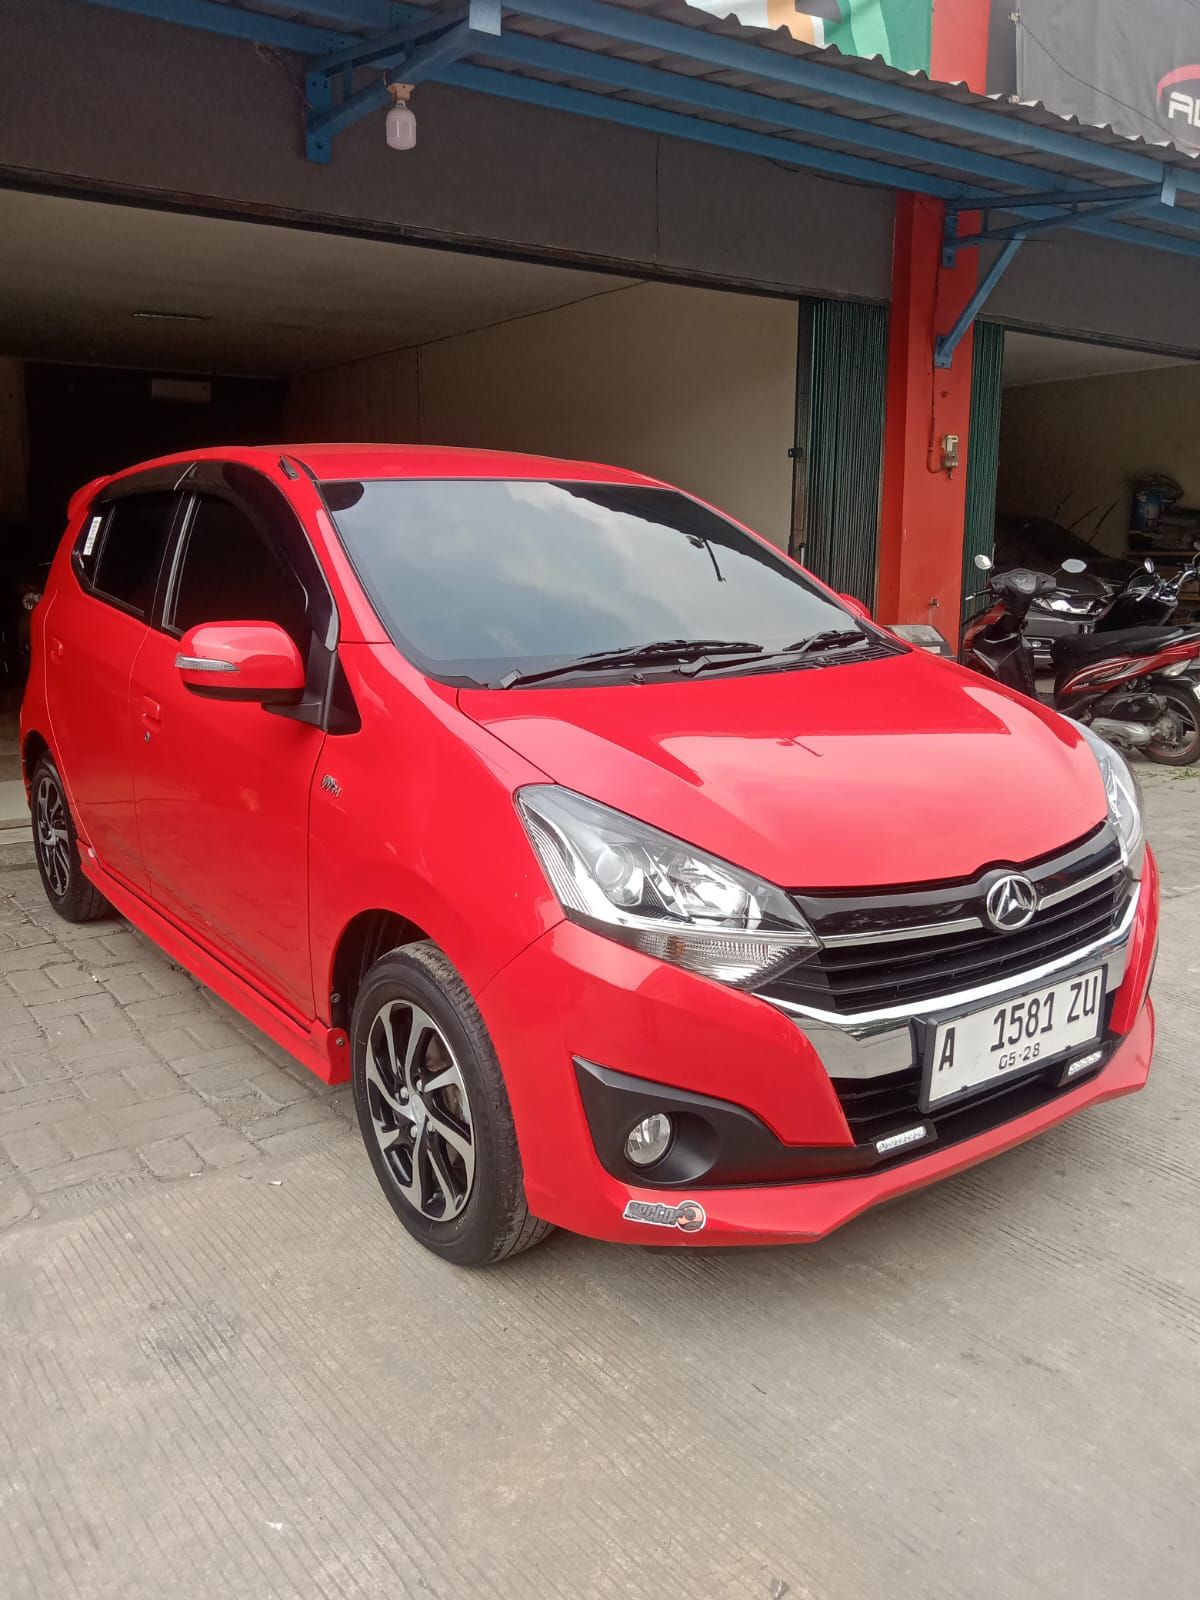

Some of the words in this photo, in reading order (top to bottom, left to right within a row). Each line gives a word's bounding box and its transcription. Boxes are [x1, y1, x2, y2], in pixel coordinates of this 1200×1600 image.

[938, 1027, 956, 1071] A
[990, 992, 1055, 1052] 1581
[1067, 975, 1098, 1024] ZU
